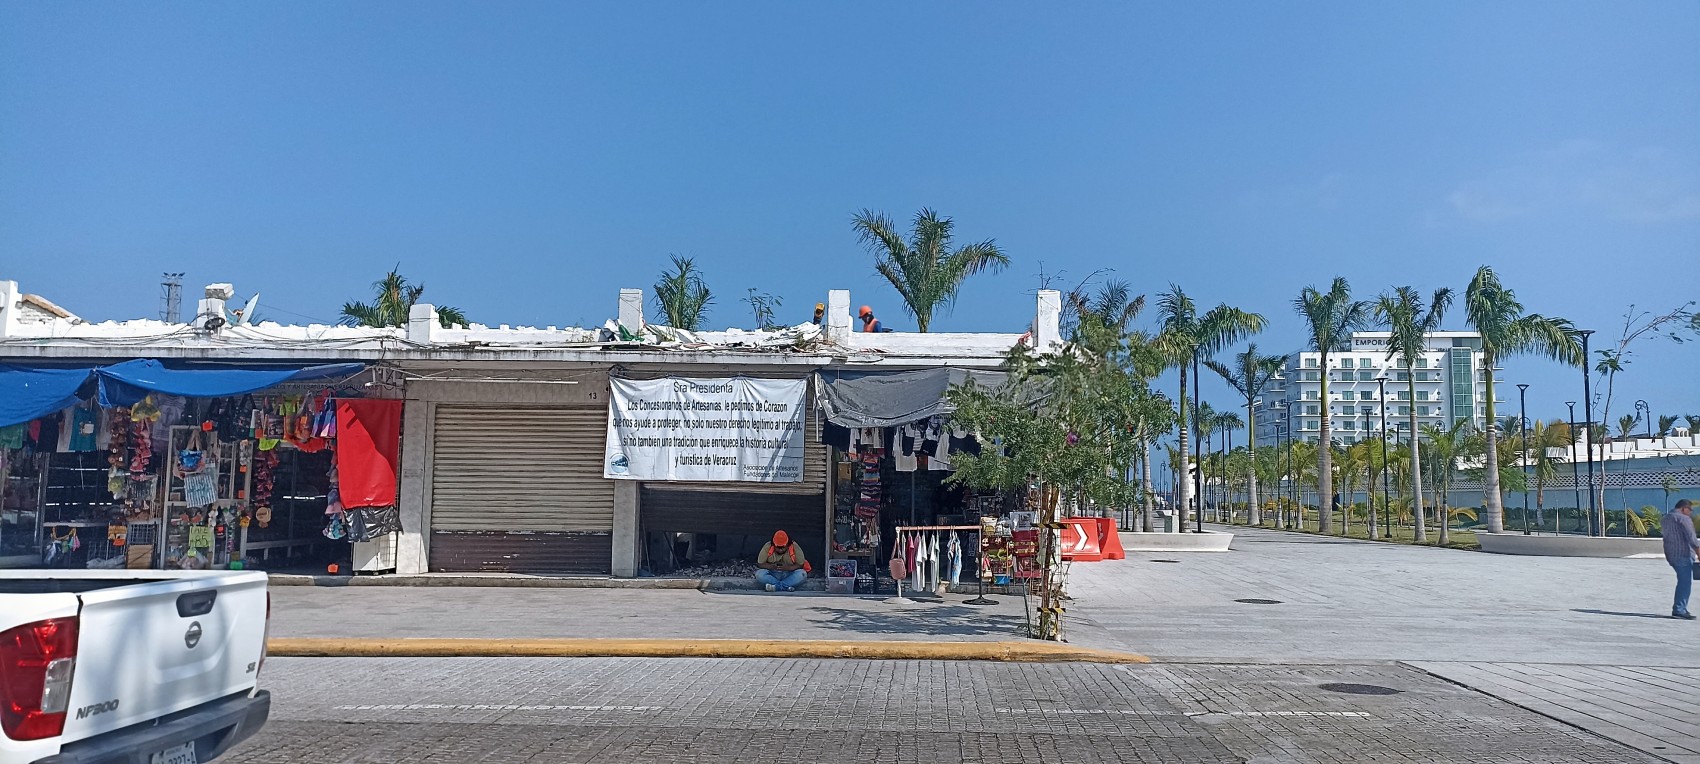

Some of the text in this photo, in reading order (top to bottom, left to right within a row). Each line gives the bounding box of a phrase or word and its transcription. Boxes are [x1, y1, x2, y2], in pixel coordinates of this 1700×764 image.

[674, 382, 732, 394] Sra Presidenta
[628, 400, 638, 410] Los
[640, 399, 682, 411] Concesionarios
[683, 399, 690, 410] de
[725, 400, 730, 411] le
[731, 399, 754, 414] pedimos
[756, 400, 762, 412] de
[613, 418, 622, 429] que
[623, 418, 632, 428] nos
[634, 416, 651, 431] ayude
[652, 419, 656, 428] a
[684, 419, 690, 429] no
[706, 418, 727, 429] nuestro
[729, 418, 750, 429] derecho
[775, 419, 780, 430] al
[662, 437, 672, 447] una
[700, 438, 710, 450] que
[712, 436, 738, 450] enriquece
[740, 437, 744, 448] la
[746, 437, 766, 449] historia
[675, 456, 678, 468] y
[704, 454, 711, 465] de
[712, 454, 736, 466] Veracruz
[76, 698, 120, 720] NP300
